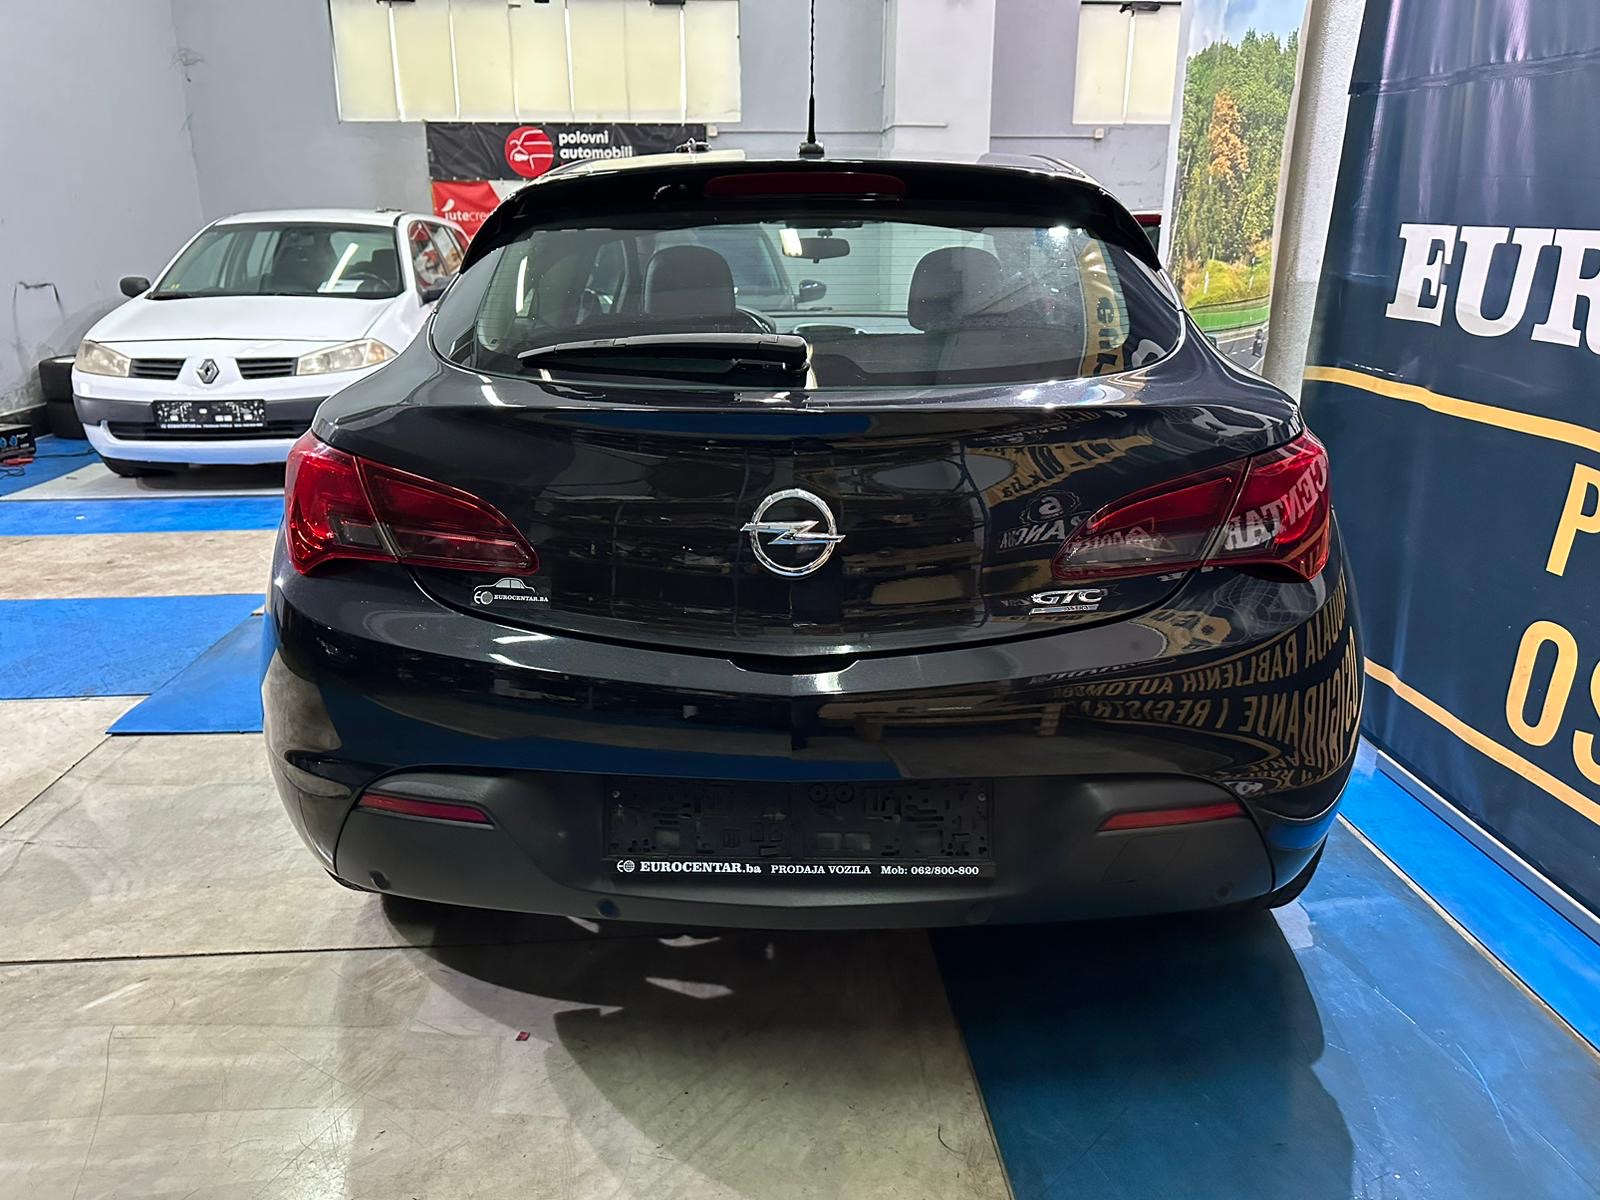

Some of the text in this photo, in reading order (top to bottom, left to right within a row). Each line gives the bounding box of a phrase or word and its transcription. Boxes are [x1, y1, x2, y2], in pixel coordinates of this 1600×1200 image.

[558, 130, 608, 146] polovni
[560, 145, 632, 159] automobili
[494, 594, 549, 602] EUROCENTAR.BA
[1031, 589, 1102, 605] GTC
[640, 861, 761, 873] EUROCENTAR.ba
[771, 864, 825, 874] PRODAJA
[828, 865, 871, 875] VOZILA
[880, 865, 908, 875] Mob:
[910, 866, 980, 875] 062/800-800
